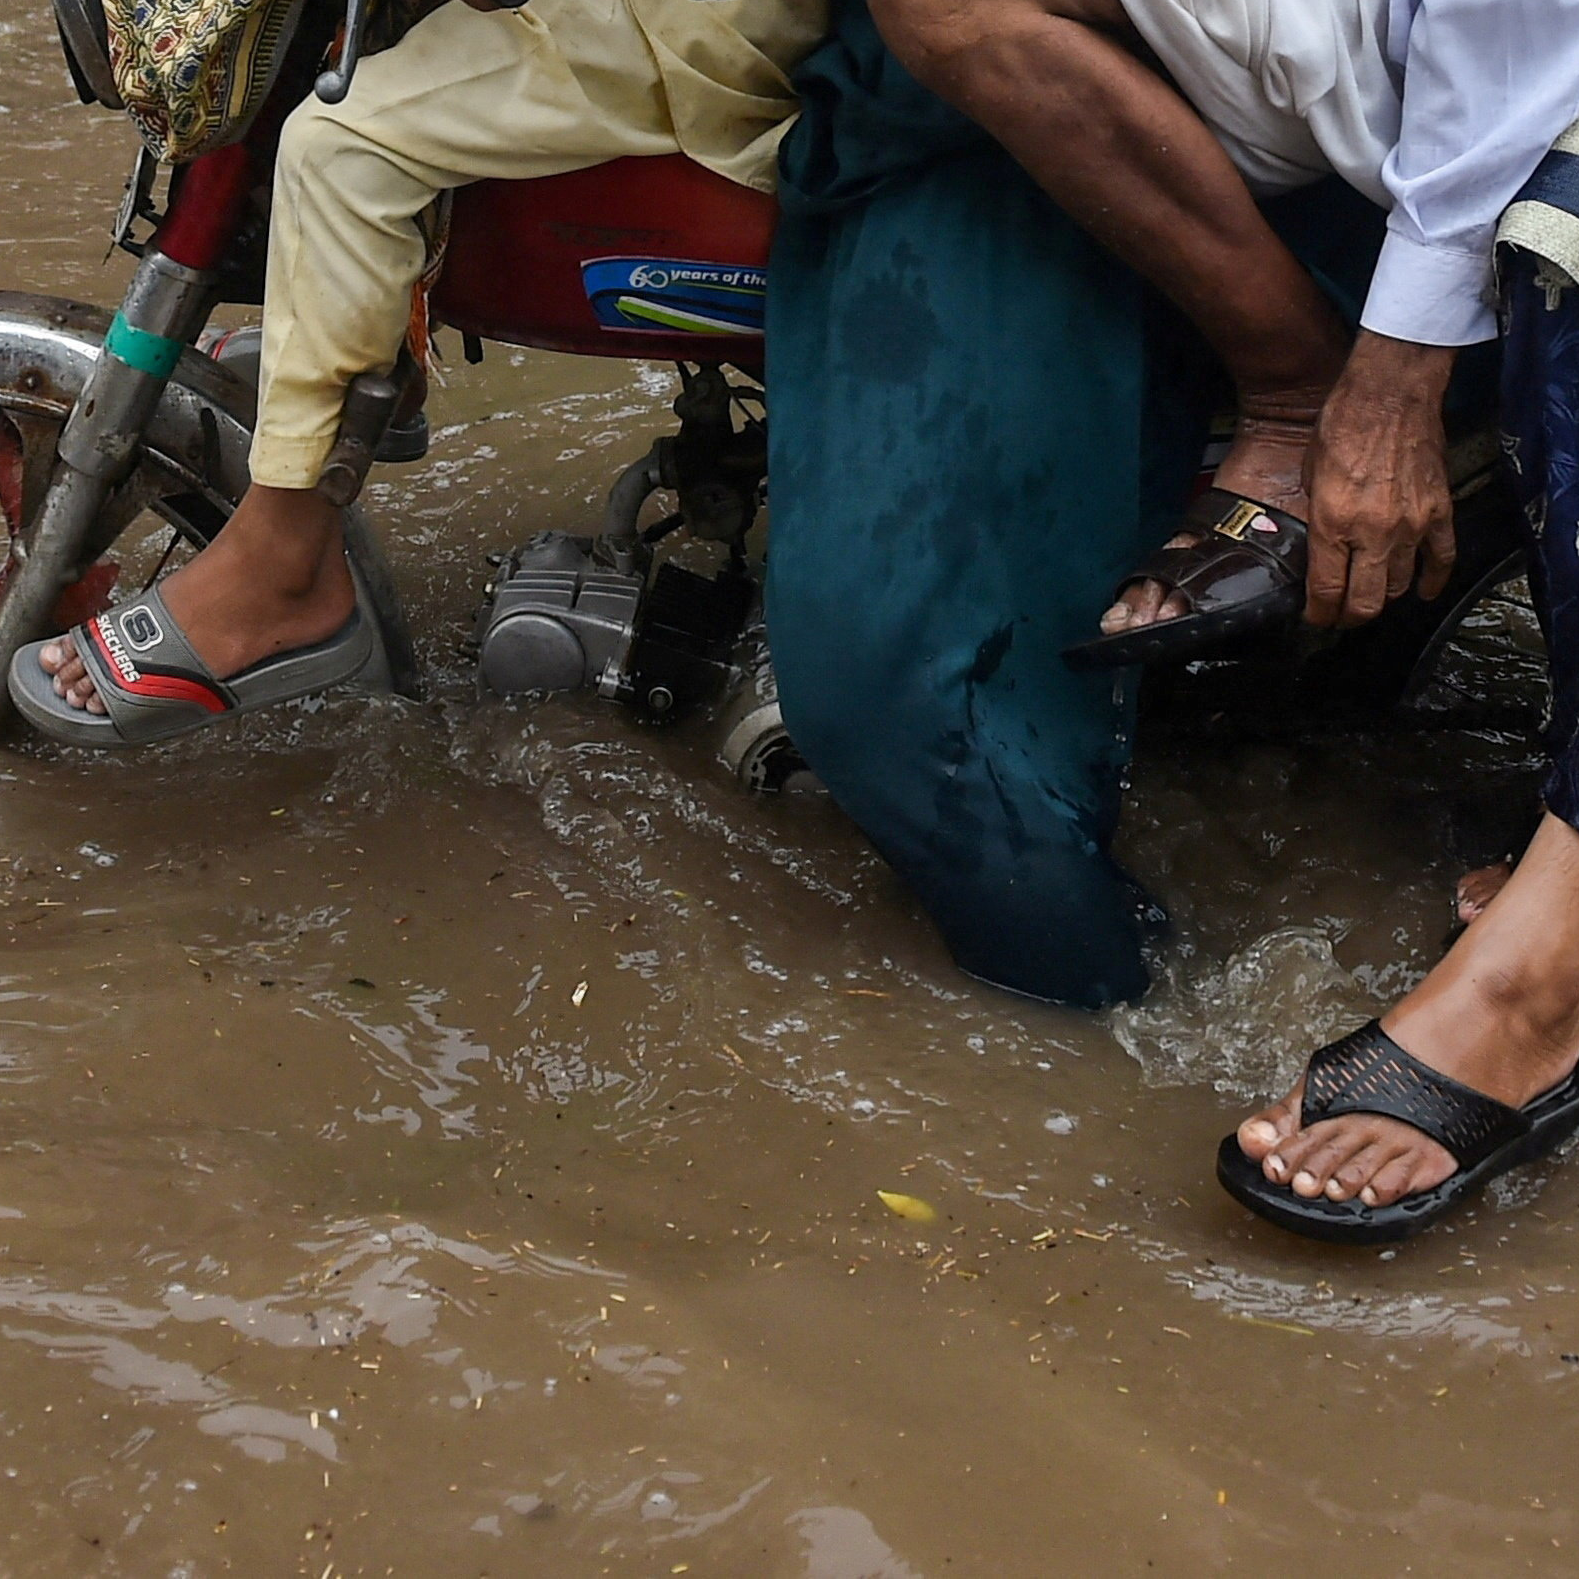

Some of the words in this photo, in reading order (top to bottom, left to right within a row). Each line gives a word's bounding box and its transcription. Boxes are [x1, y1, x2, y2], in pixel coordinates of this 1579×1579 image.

[629, 264, 669, 289] 60
[670, 269, 719, 282] years
[722, 271, 742, 286] of
[96, 613, 142, 683] SKECHERS
